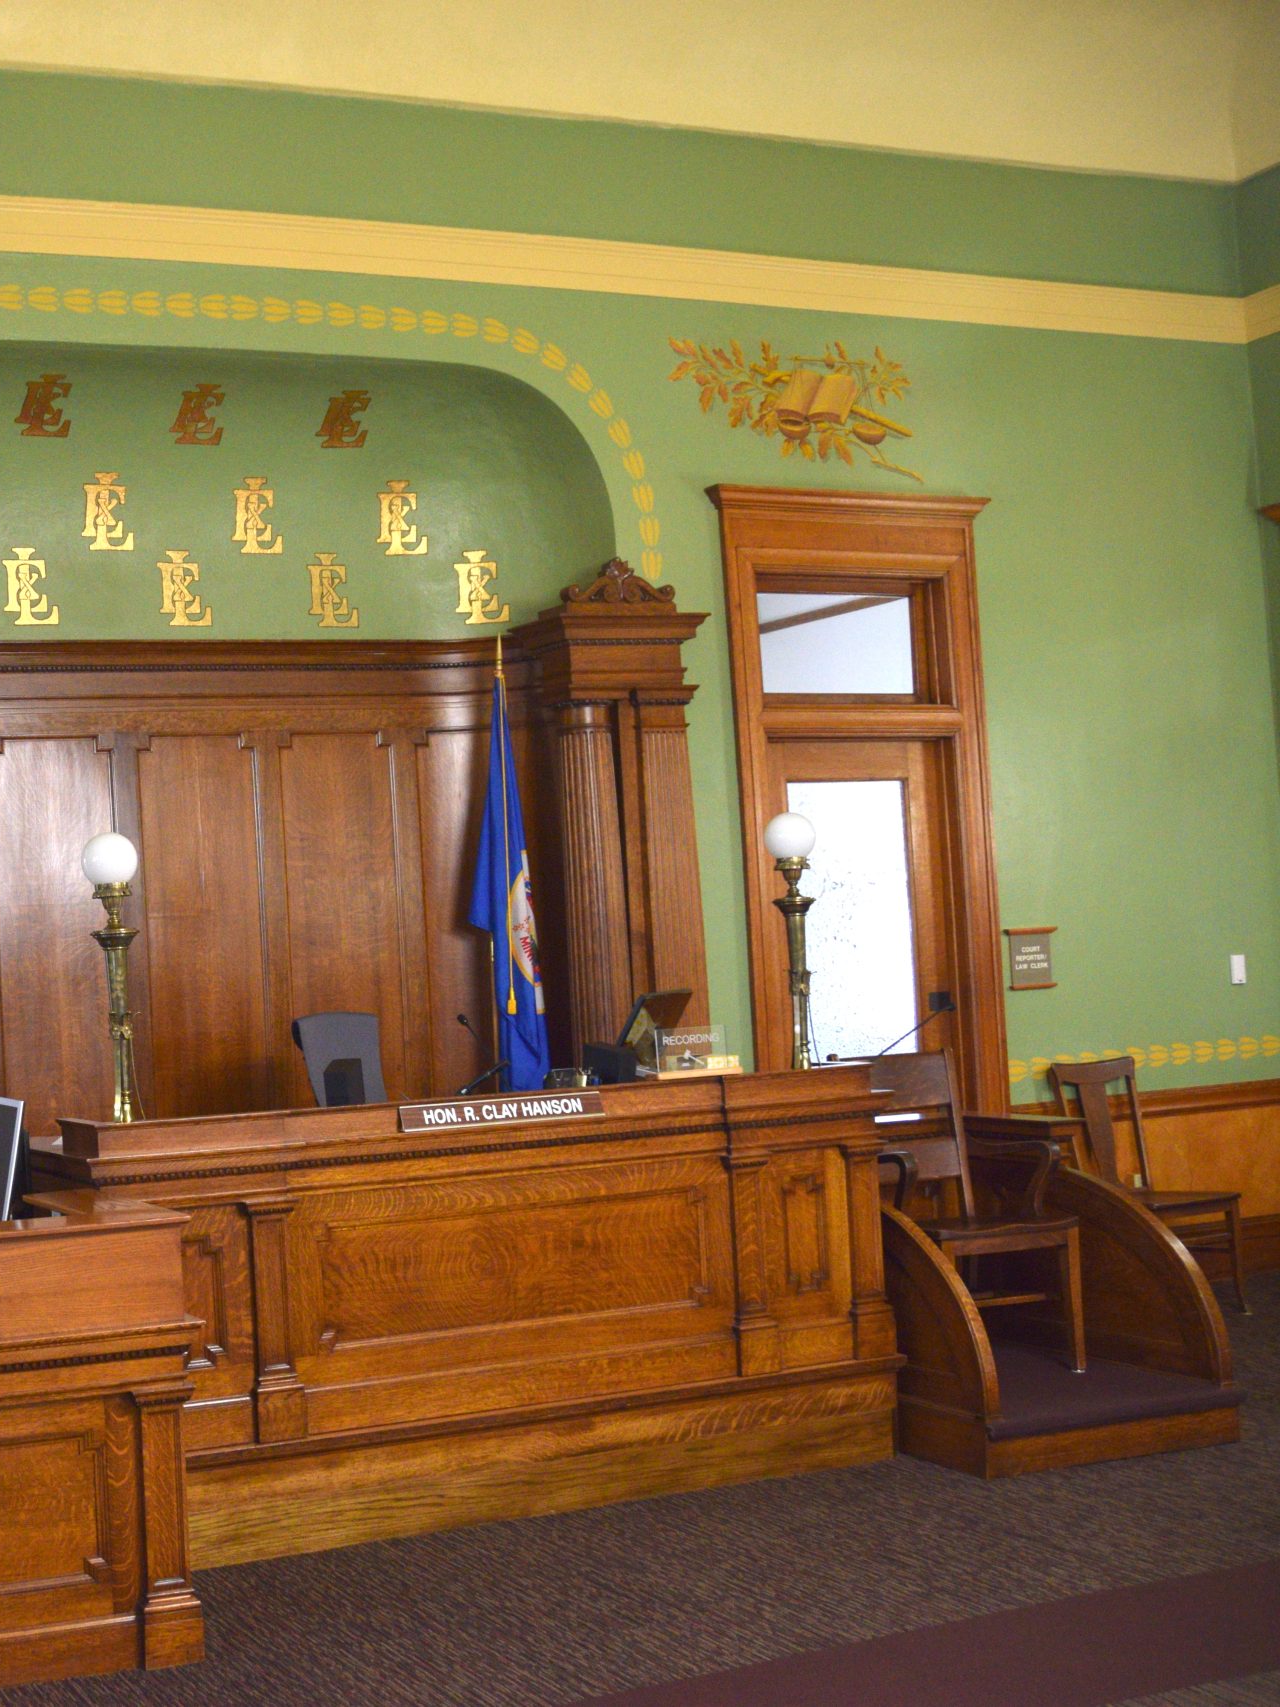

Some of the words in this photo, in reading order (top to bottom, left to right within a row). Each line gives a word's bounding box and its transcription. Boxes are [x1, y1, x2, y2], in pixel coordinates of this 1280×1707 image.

[662, 1032, 720, 1046] RECORDING
[422, 1107, 462, 1125] HON.
[463, 1106, 480, 1122] R.
[481, 1102, 518, 1120] CLAY
[521, 1098, 583, 1117] HANSON
